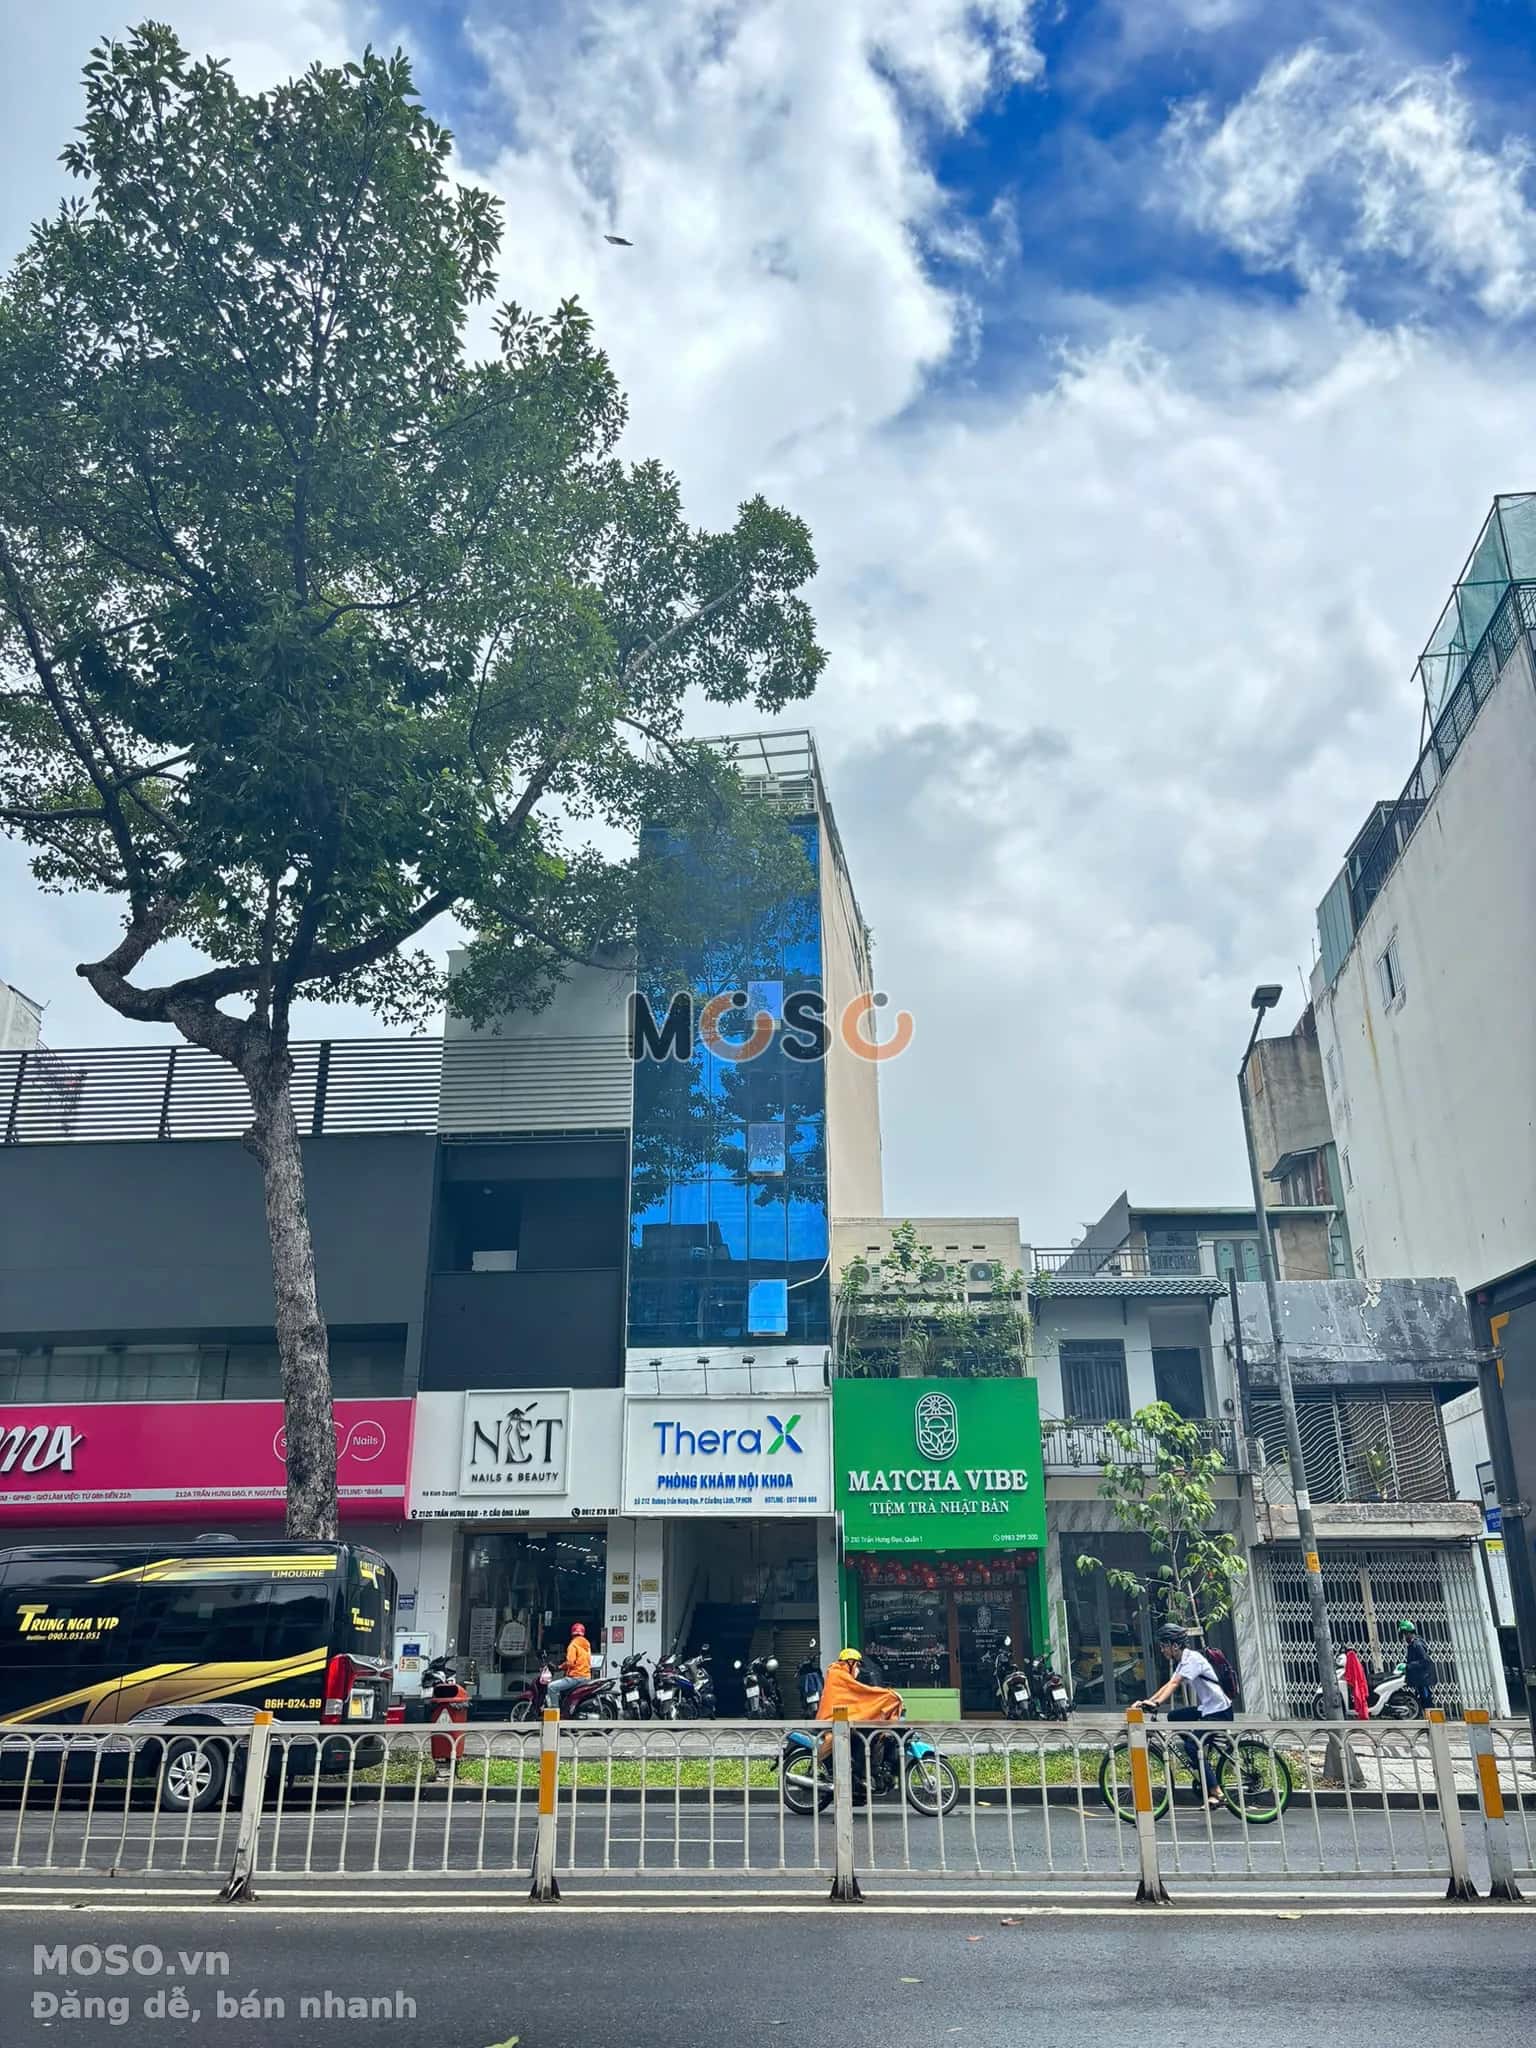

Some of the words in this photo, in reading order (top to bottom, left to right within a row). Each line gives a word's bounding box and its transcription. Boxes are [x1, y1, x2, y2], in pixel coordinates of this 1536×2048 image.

[352, 1435, 379, 1446] Nails
[653, 1414, 803, 1456] TheraX
[470, 1472, 503, 1483] NAILS
[506, 1473, 513, 1482] &
[517, 1471, 560, 1482] BEAUTY
[657, 1472, 698, 1489] PHÒNG
[700, 1471, 736, 1488] KHÁM
[738, 1472, 759, 1491] NỘI
[761, 1473, 794, 1488] KHOA
[848, 1469, 962, 1492] MATCHA
[965, 1469, 1029, 1491] VIBE
[175, 1490, 192, 1498] 212A
[419, 1509, 433, 1517] 212C
[434, 1508, 448, 1517] TRẦN
[869, 1500, 905, 1516] TIỆM
[908, 1497, 936, 1514] TRÀ
[940, 1499, 978, 1515] NHẬT
[981, 1497, 1009, 1513] BẢN
[271, 1569, 325, 1578] LIMOUSINE
[16, 1604, 65, 1632] TRUNG
[66, 1617, 93, 1631] NGA
[97, 1616, 119, 1630] VIP
[636, 1608, 657, 1624] 212
[264, 1698, 322, 1709] 86H-024.99
